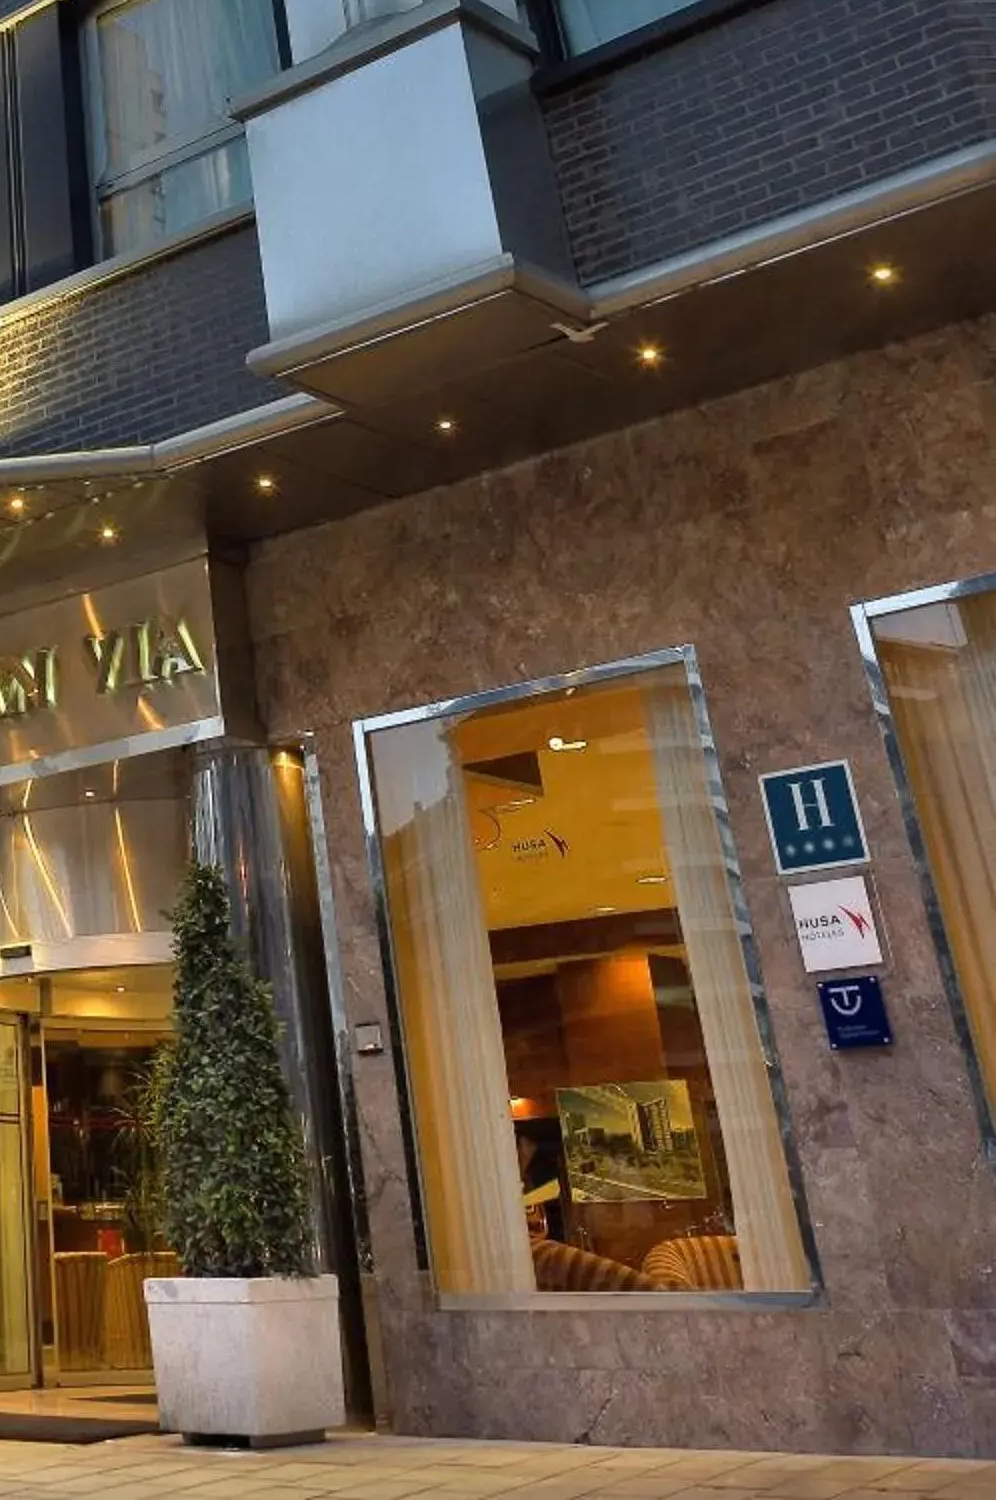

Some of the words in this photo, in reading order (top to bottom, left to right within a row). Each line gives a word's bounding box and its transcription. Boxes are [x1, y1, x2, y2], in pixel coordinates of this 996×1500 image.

[83, 618, 205, 694] VIA
[788, 776, 835, 831] H
[512, 839, 546, 852] HUSA
[799, 915, 841, 929] HUSA
